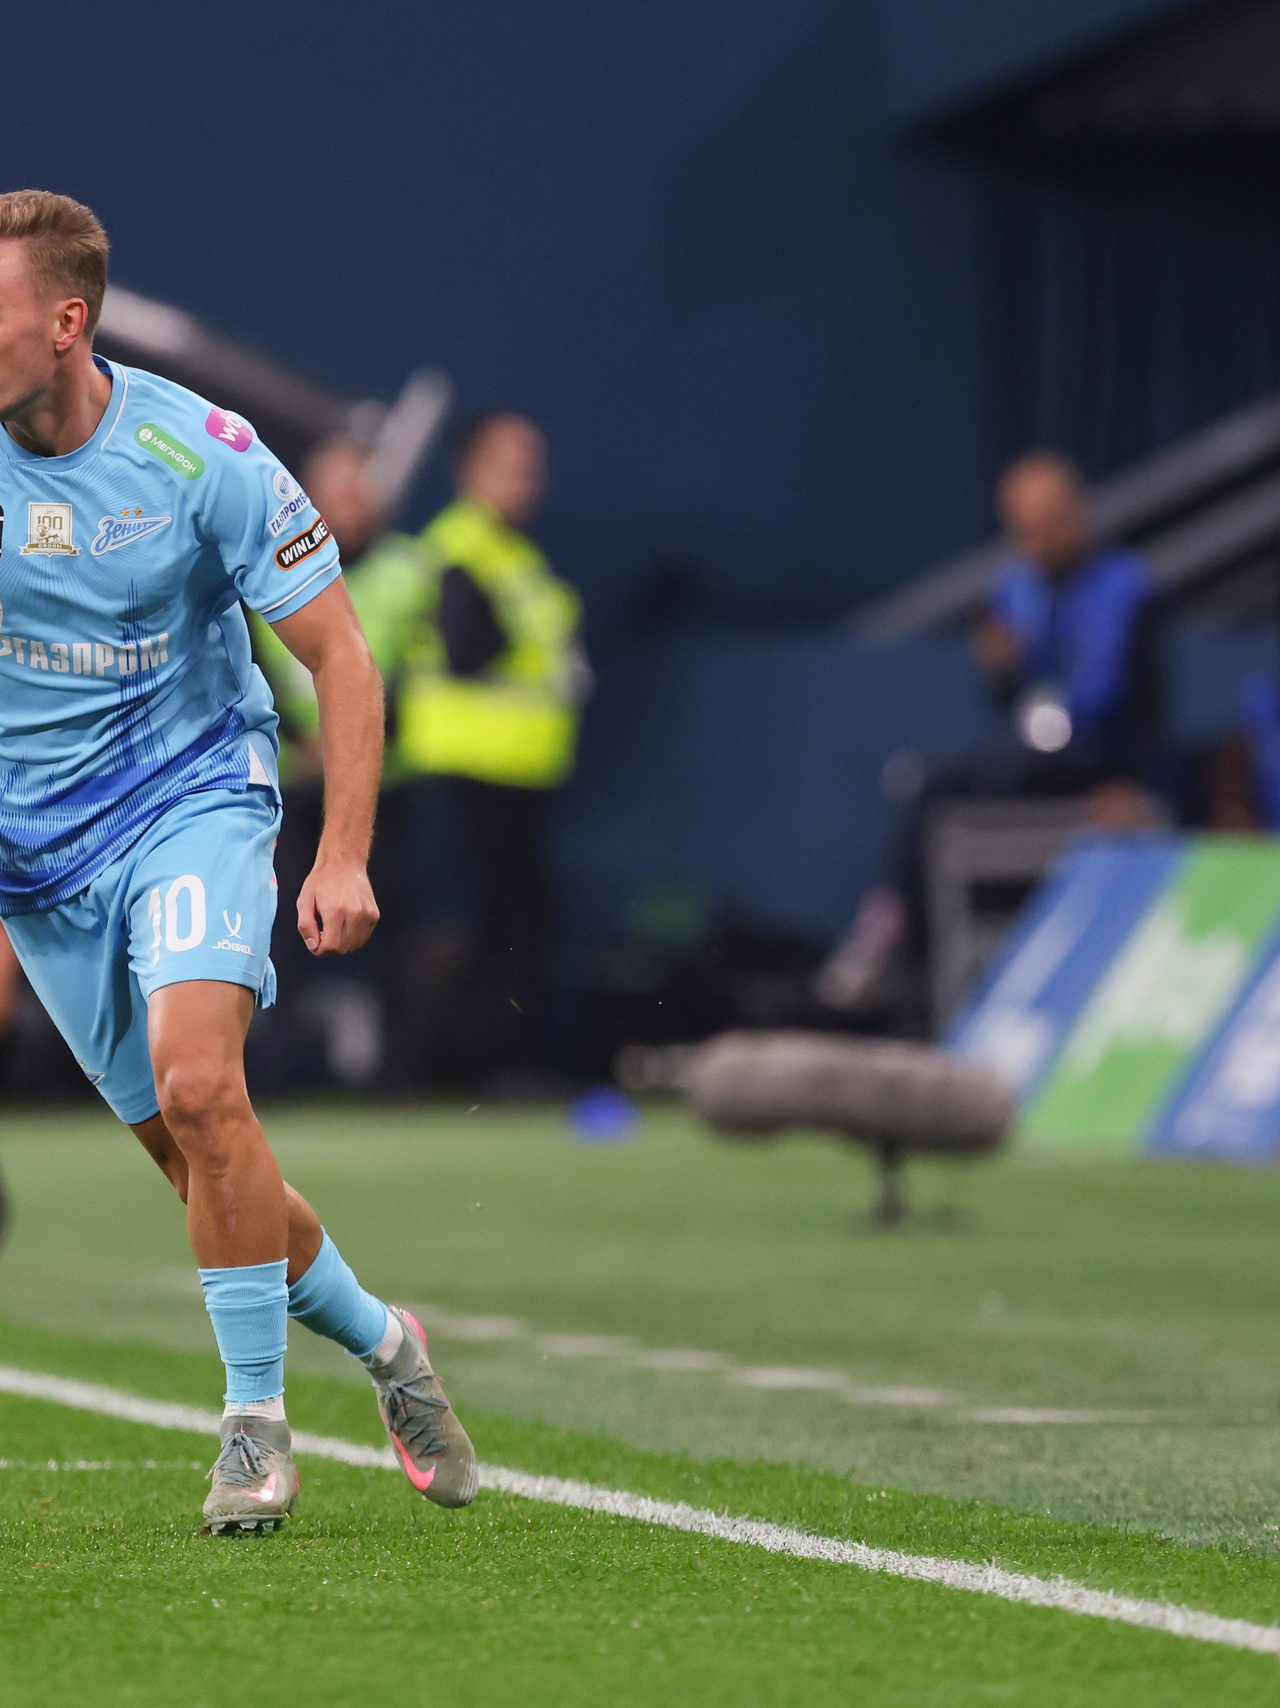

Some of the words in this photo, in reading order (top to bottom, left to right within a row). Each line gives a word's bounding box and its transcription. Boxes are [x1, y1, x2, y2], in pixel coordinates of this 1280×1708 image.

[150, 436, 197, 473] МЕГАФОН
[37, 515, 63, 530] 100
[280, 521, 328, 565] WINLINE
[12, 632, 169, 677] ГАЗПРОМ
[148, 874, 207, 967] 10
